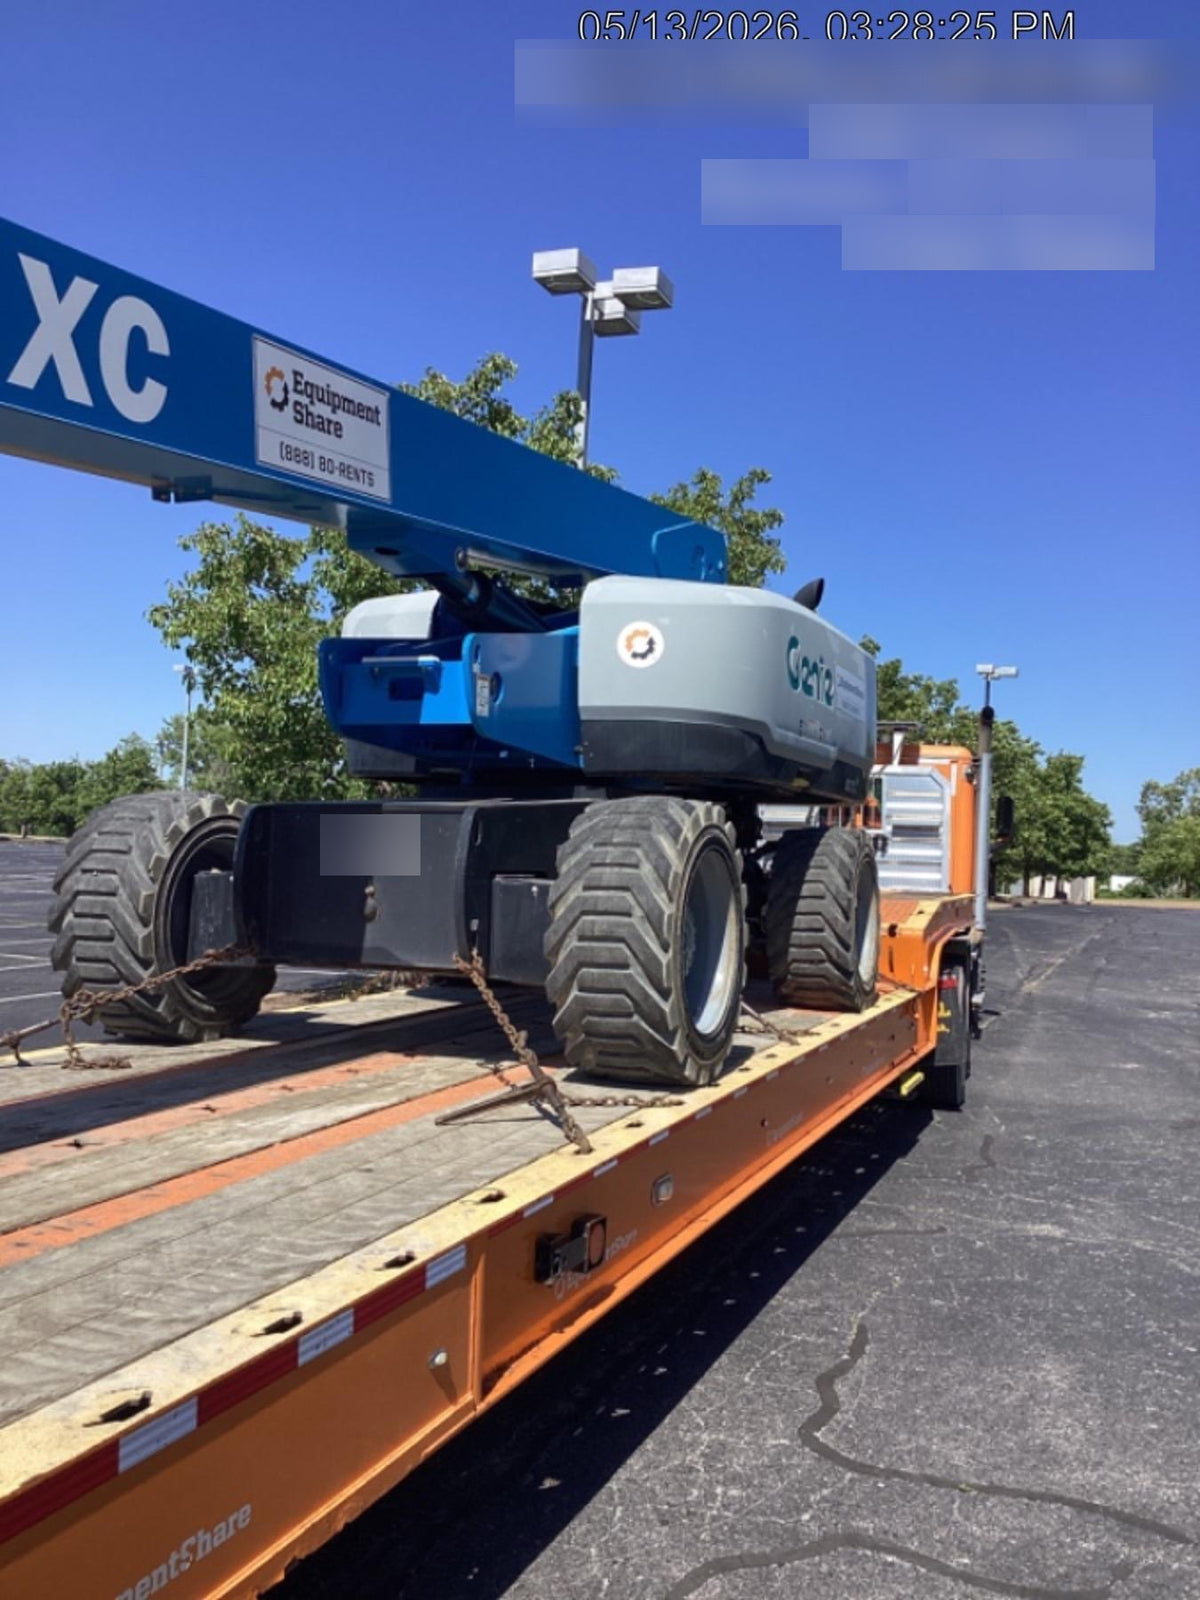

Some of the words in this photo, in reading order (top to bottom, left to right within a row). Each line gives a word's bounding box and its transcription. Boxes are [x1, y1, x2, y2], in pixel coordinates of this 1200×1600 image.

[7, 252, 170, 423] XC
[292, 369, 382, 426] Equipment
[293, 400, 344, 439] Share
[280, 441, 315, 470] (888)
[787, 635, 834, 706] Genie
